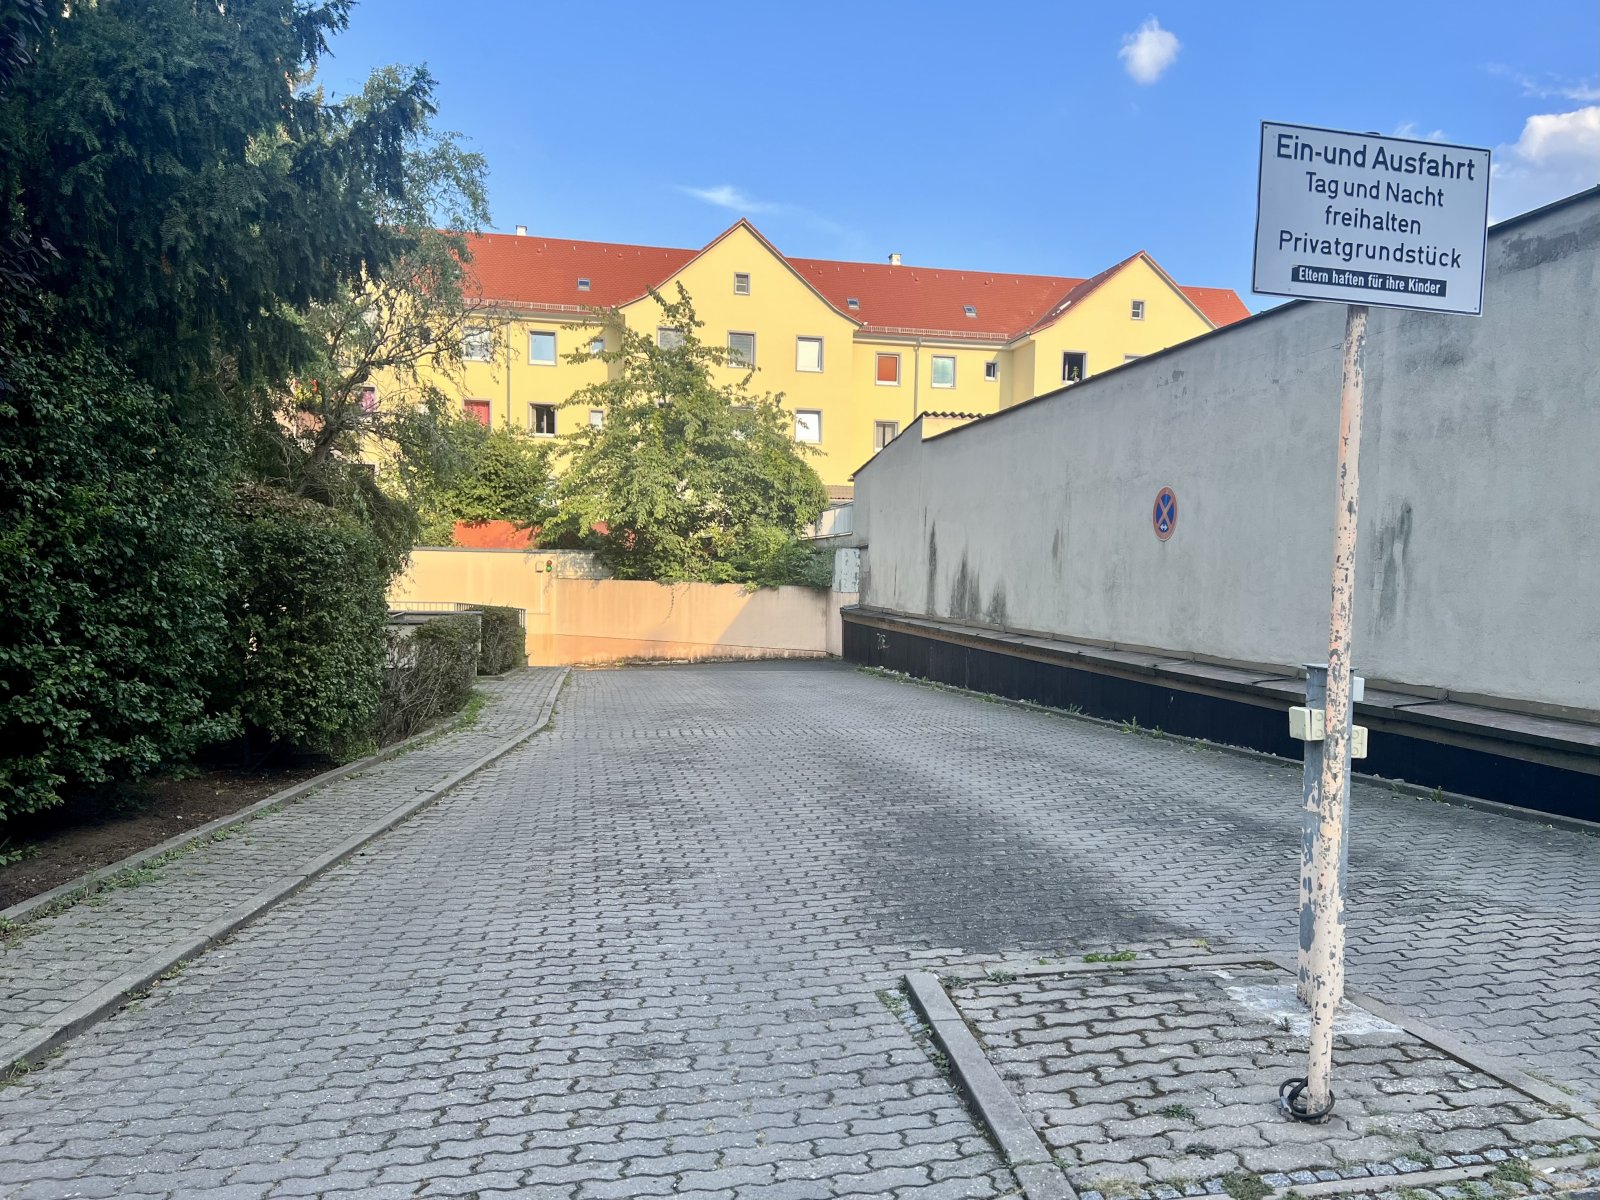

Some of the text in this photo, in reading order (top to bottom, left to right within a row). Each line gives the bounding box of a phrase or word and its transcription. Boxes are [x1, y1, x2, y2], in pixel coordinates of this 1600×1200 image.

[1372, 146, 1475, 181] Ausfahrt
[1306, 171, 1444, 207] Tag und Nacht
[1325, 205, 1421, 235] freihalten
[1279, 230, 1461, 268] Privatgrundstück
[1299, 266, 1441, 295] Eltern haften für ihre Kinder
